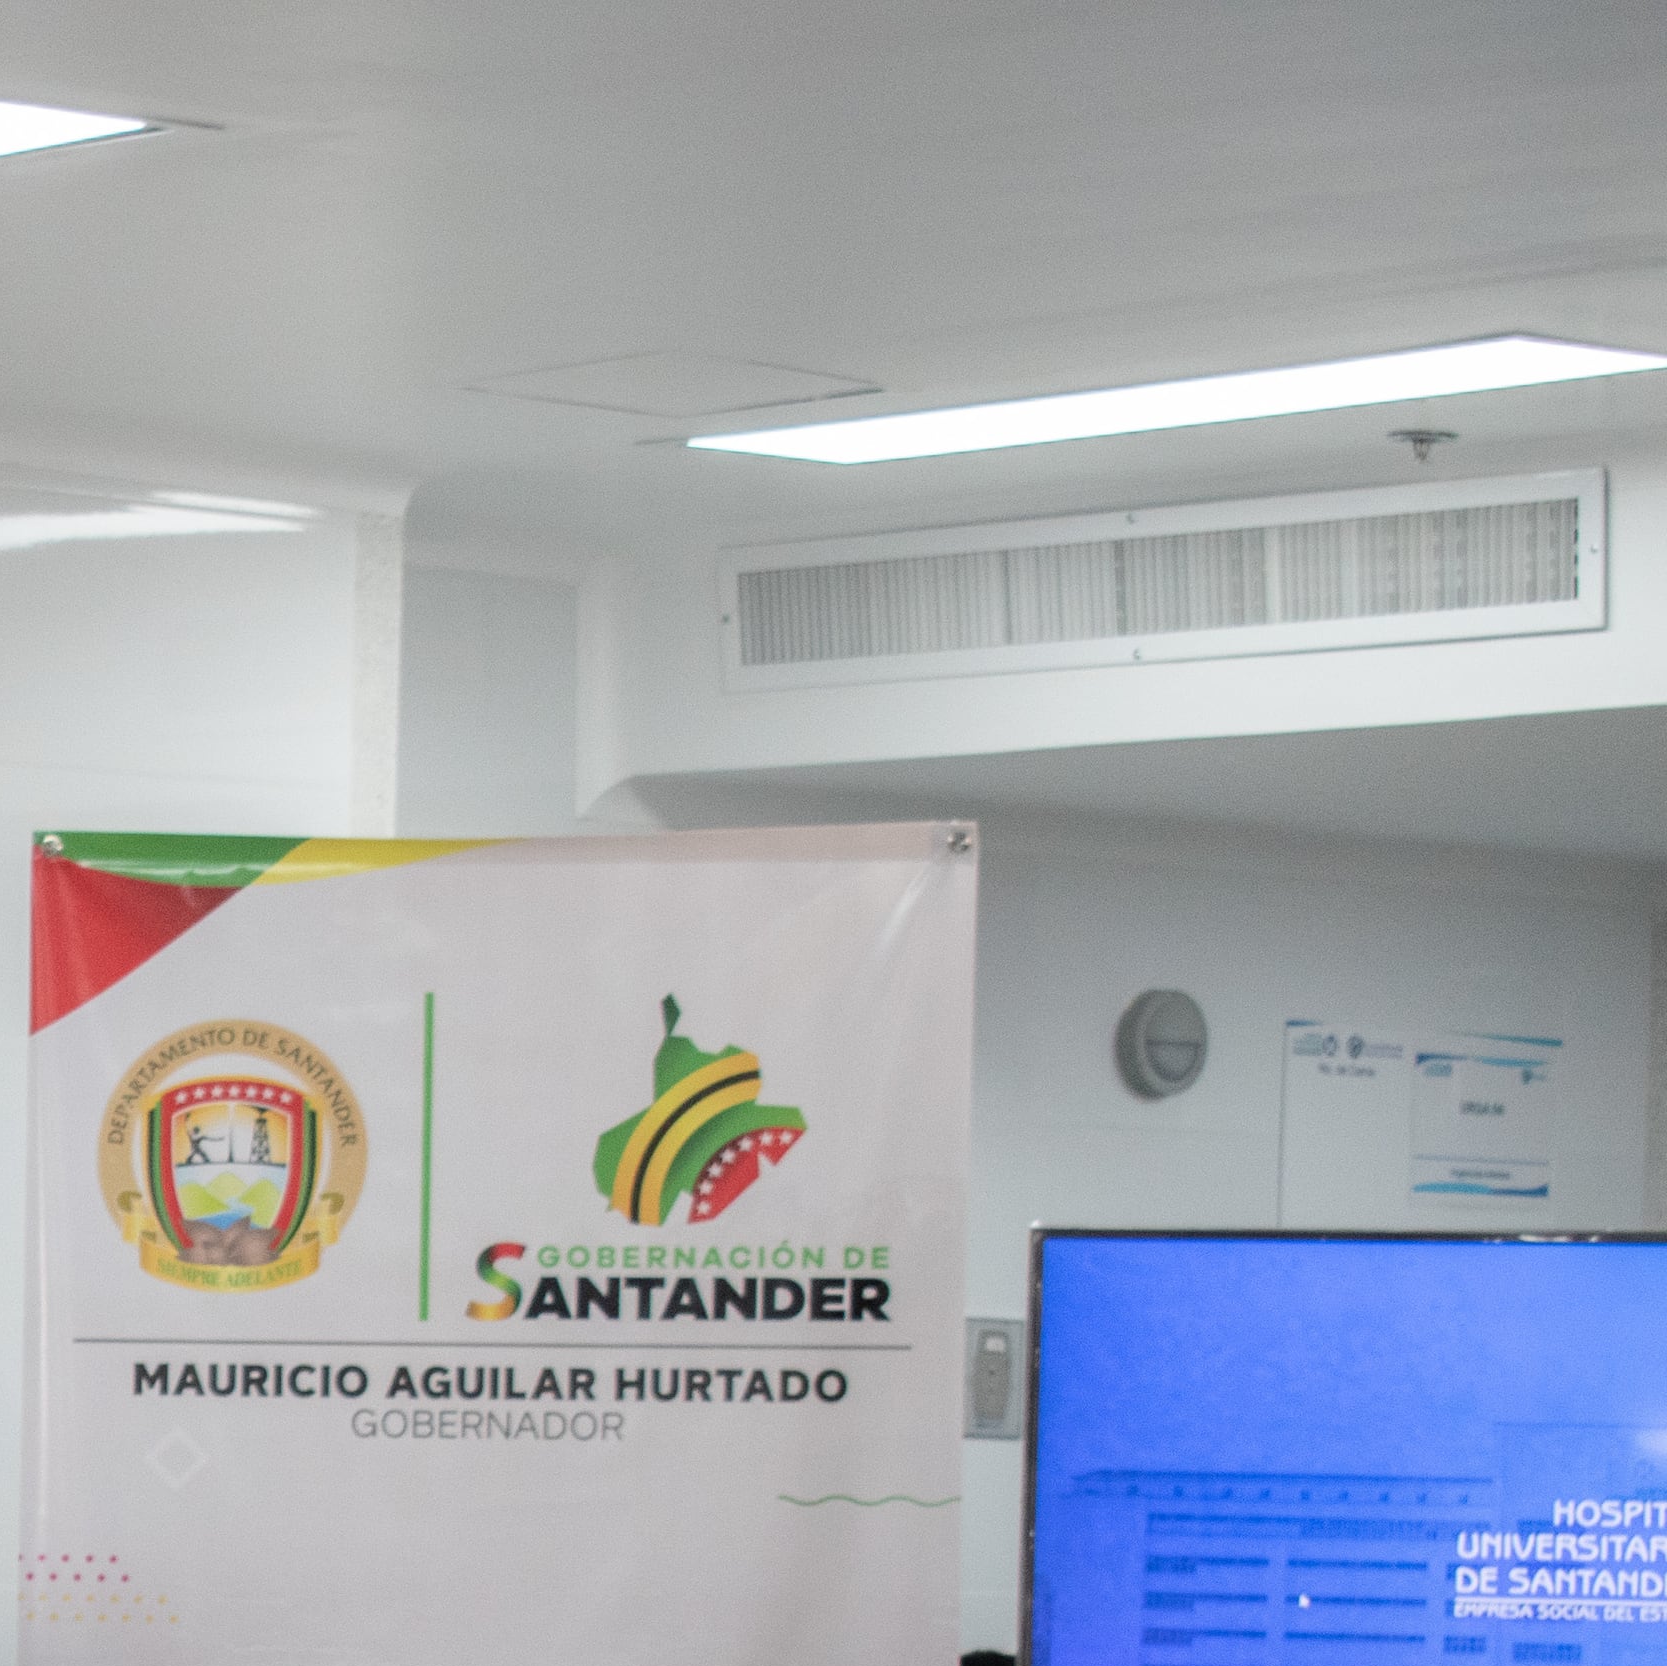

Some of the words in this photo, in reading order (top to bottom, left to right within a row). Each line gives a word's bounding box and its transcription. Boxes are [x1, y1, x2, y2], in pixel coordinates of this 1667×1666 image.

[107, 1028, 235, 1146] DEPARTAMENTO
[242, 1028, 271, 1049] DE
[276, 1038, 359, 1148] SANTANDER
[536, 1239, 825, 1270] GOBERNACIÓN
[843, 1246, 891, 1270] DE
[466, 1242, 891, 1322] SANTANDER
[133, 1362, 370, 1398] MAURICIO
[385, 1366, 596, 1400] AGUILAR
[613, 1367, 848, 1402] HURTADO
[351, 1408, 625, 1441] GOBERNADOR
[1553, 1500, 1667, 1527] HOSPIT
[1456, 1532, 1667, 1562] UNIVERSITAR
[1455, 1567, 1498, 1594] DE
[1508, 1567, 1667, 1597] SANTAND
